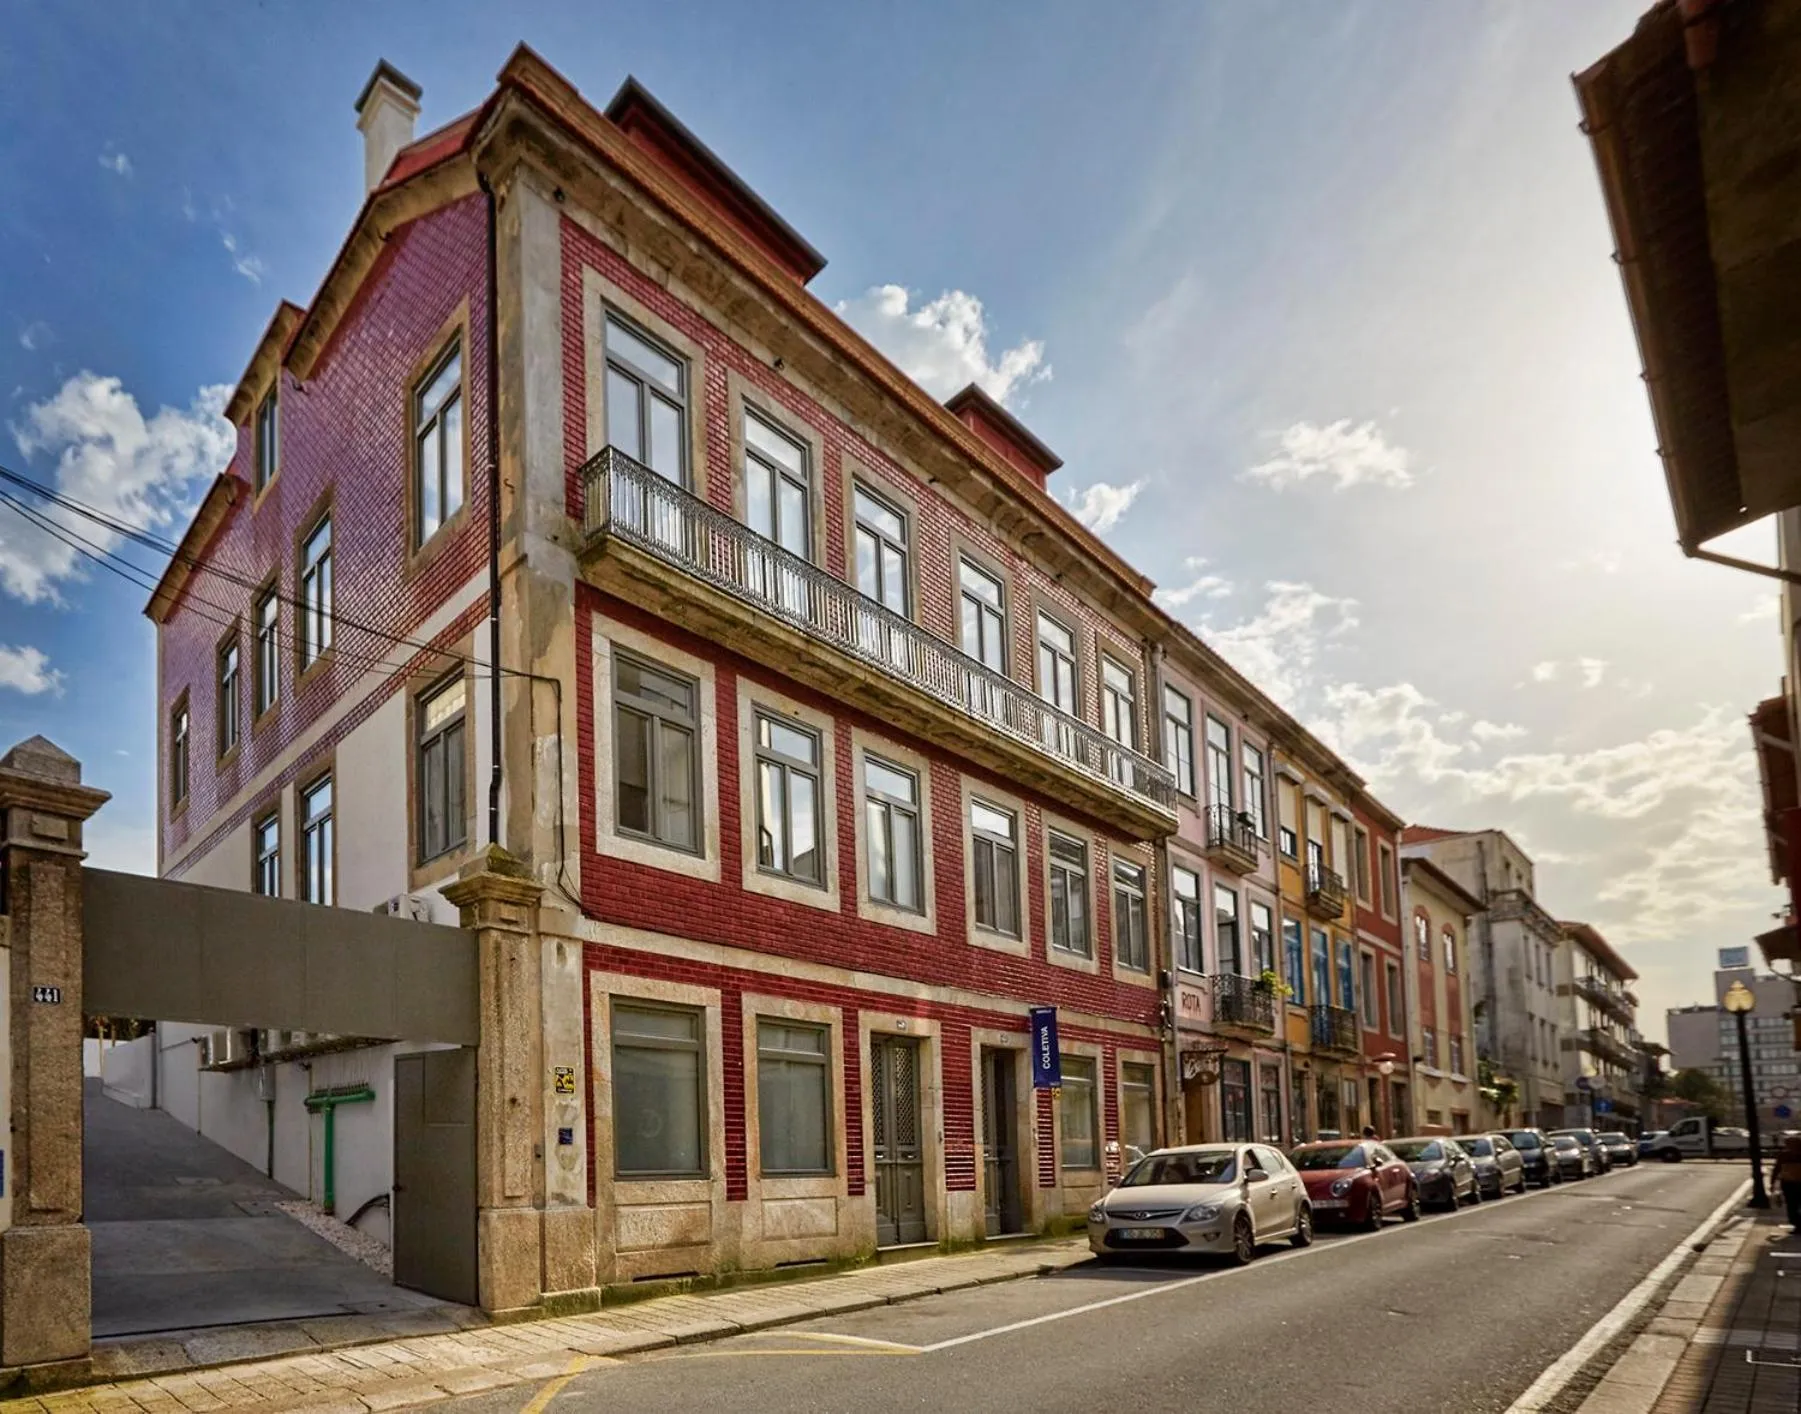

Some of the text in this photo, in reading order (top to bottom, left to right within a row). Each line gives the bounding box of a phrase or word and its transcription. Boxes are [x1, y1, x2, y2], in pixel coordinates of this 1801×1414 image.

[36, 988, 58, 1002] 441
[1181, 991, 1201, 1013] ROTA
[1040, 1026, 1051, 1070] COLETIVA
